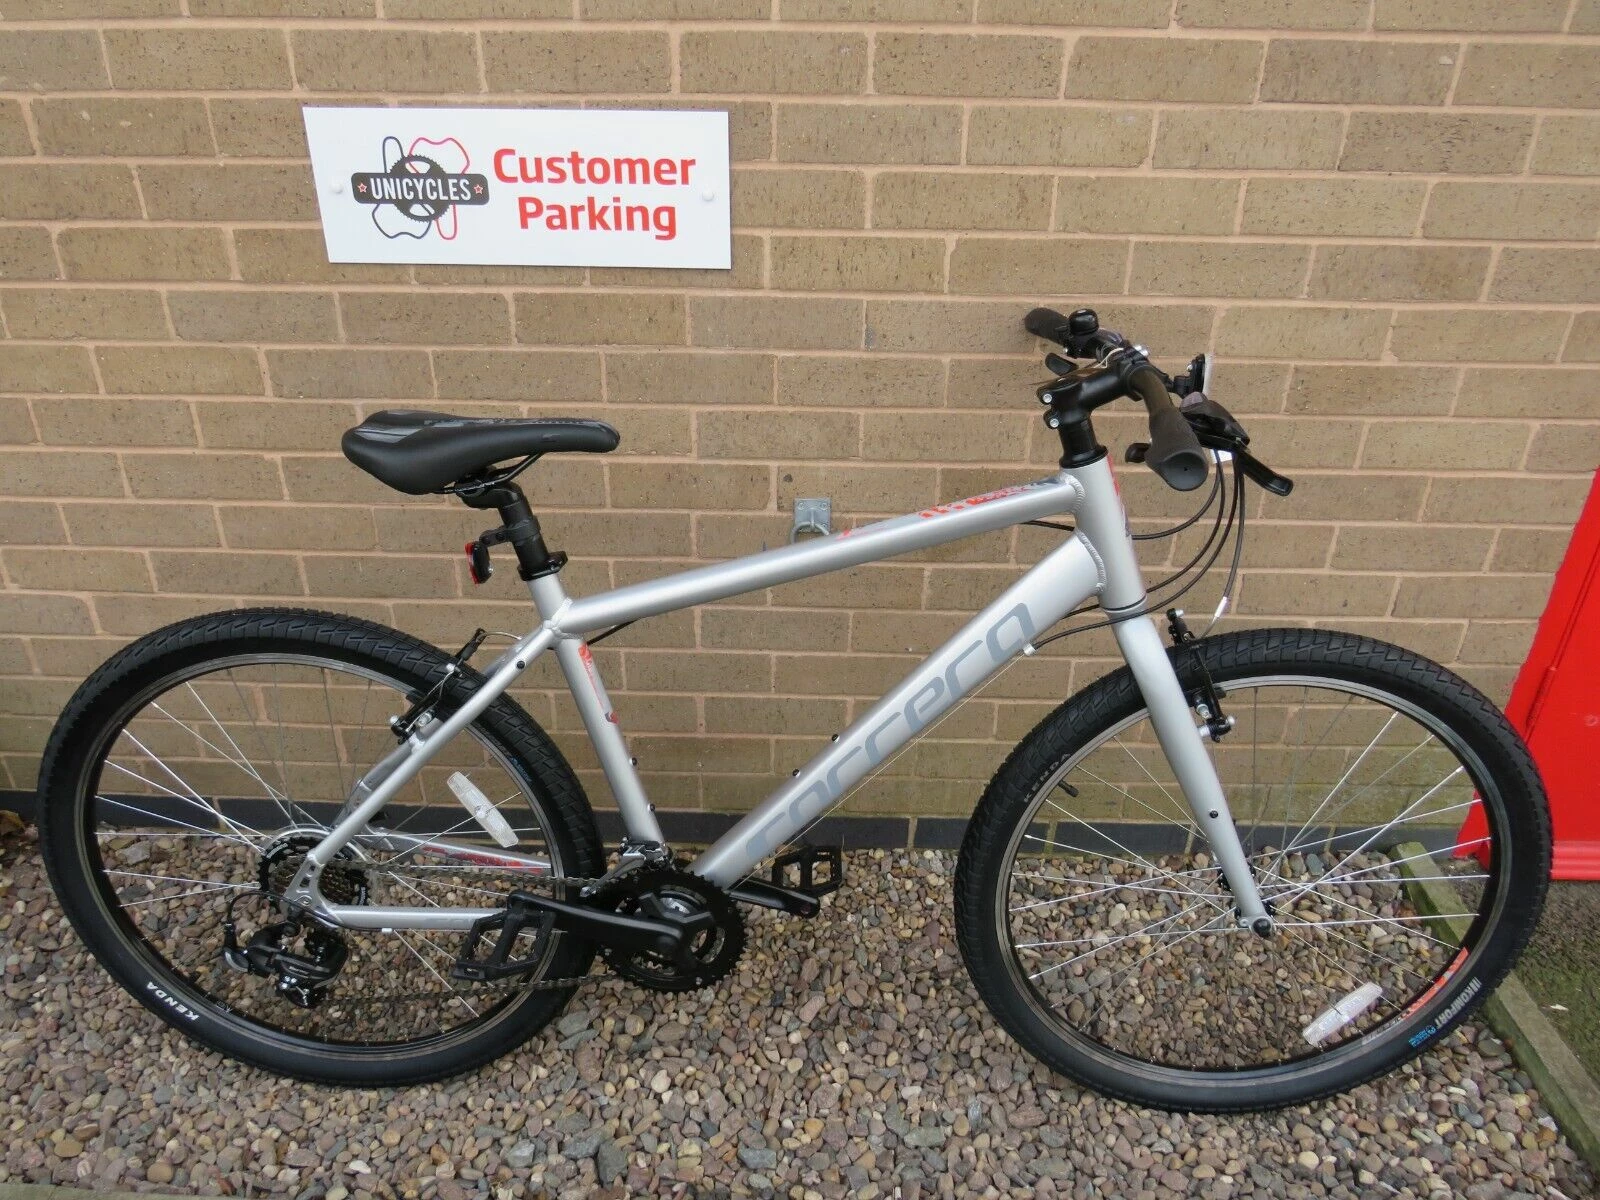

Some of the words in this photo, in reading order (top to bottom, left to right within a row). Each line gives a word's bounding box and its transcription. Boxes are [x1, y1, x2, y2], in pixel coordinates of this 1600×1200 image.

[493, 148, 697, 186] Customer
[369, 177, 472, 202] UNICYCLES
[518, 196, 677, 241] Parking
[147, 981, 200, 1021] KENDA
[1435, 985, 1477, 1029] KOMFORT
